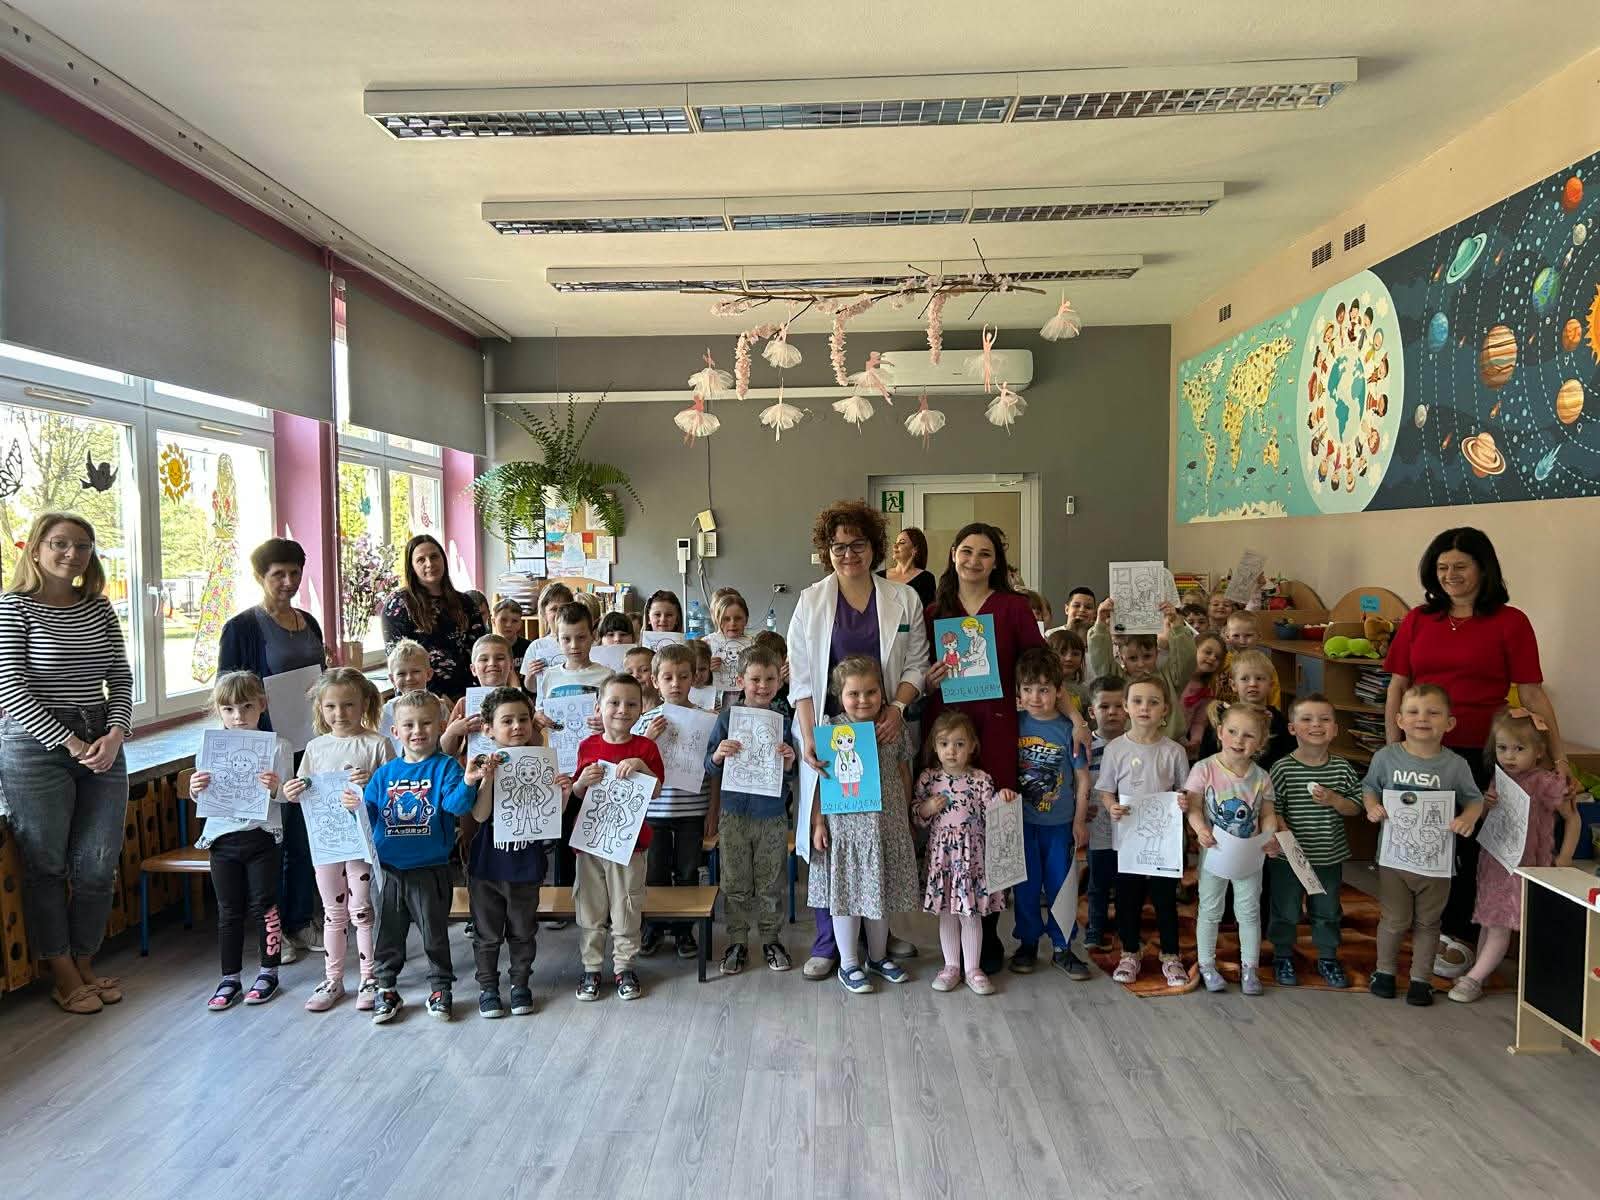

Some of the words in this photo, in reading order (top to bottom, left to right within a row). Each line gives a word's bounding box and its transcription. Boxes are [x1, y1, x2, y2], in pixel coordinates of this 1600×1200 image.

[387, 778, 432, 791] ソニック
[1392, 769, 1441, 790] NASA
[263, 908, 281, 956] HUGS
